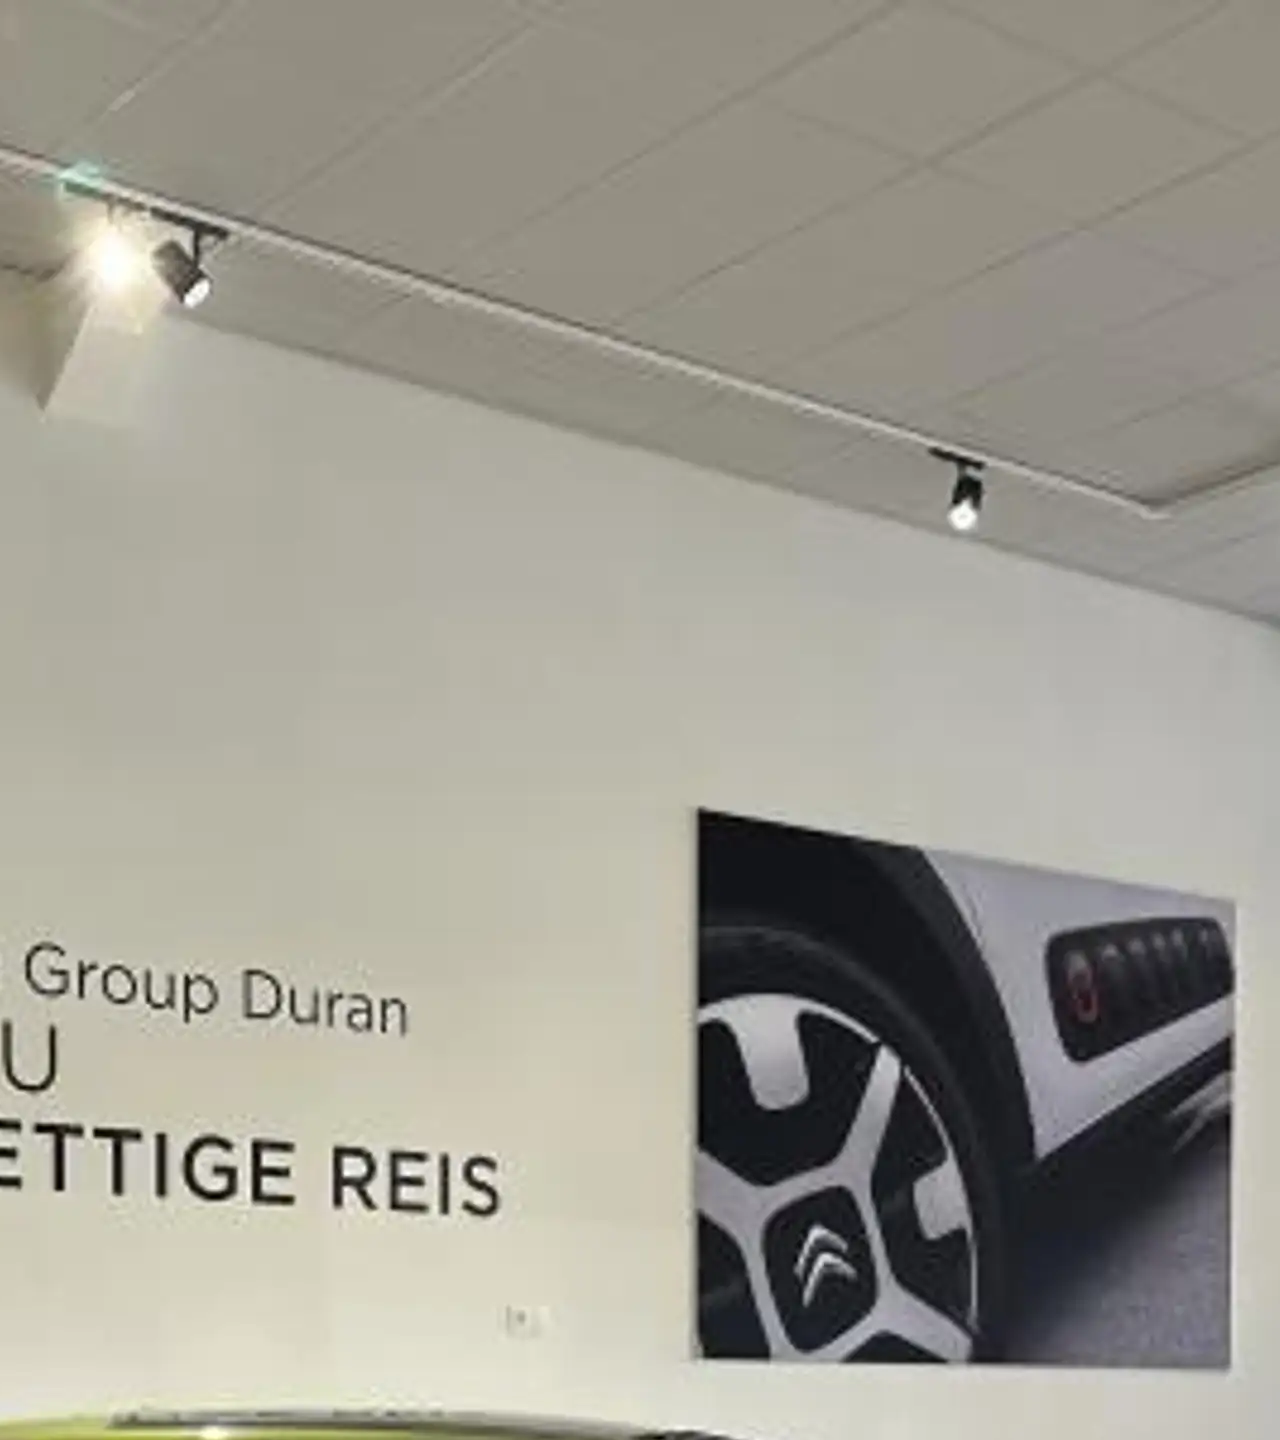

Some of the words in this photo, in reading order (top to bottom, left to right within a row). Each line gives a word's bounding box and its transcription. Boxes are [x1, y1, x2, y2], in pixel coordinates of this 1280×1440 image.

[23, 939, 222, 1024] Group
[241, 965, 412, 1038] Duran
[0, 1018, 59, 1096] U
[330, 1143, 502, 1220] REIS
